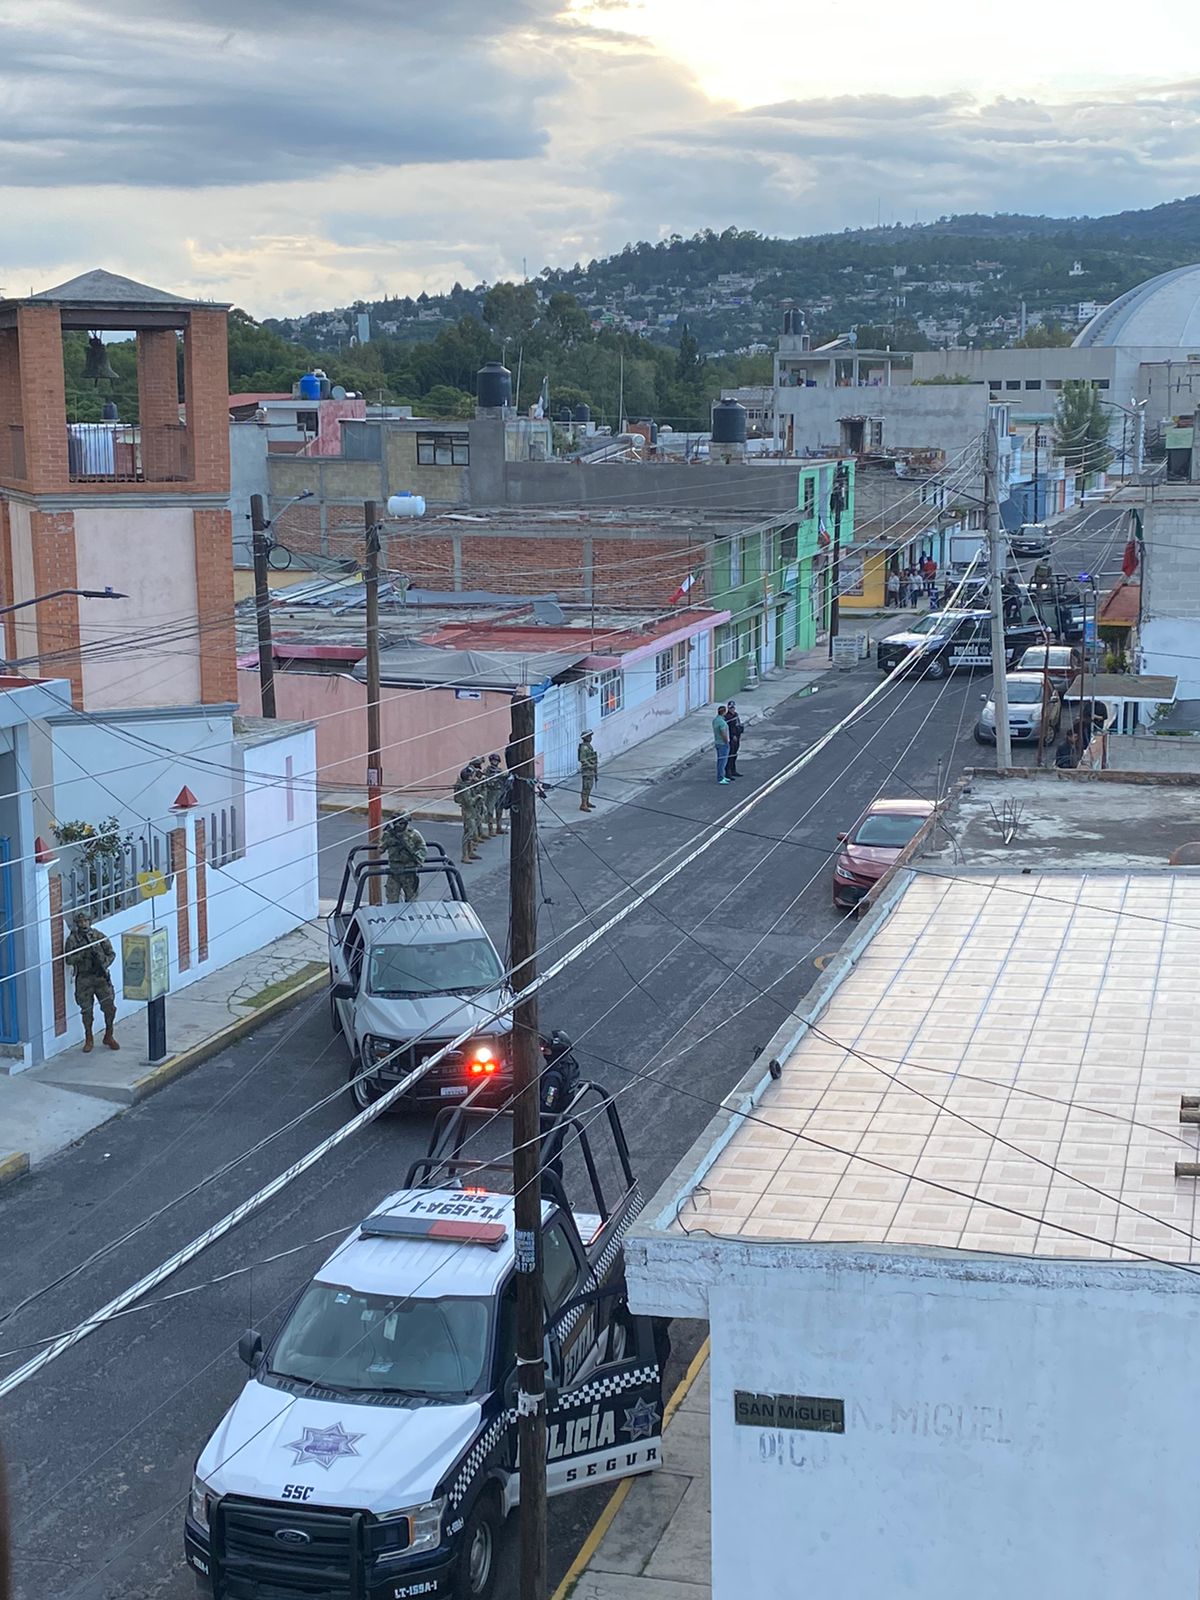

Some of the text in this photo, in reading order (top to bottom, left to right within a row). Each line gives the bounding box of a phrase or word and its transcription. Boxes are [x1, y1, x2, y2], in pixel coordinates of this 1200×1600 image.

[367, 913, 471, 925] MARINA
[739, 1402, 774, 1418] SAN
[515, 1404, 616, 1469] LICÍA
[566, 1447, 657, 1482] SEGUR
[281, 1484, 315, 1501] SSC
